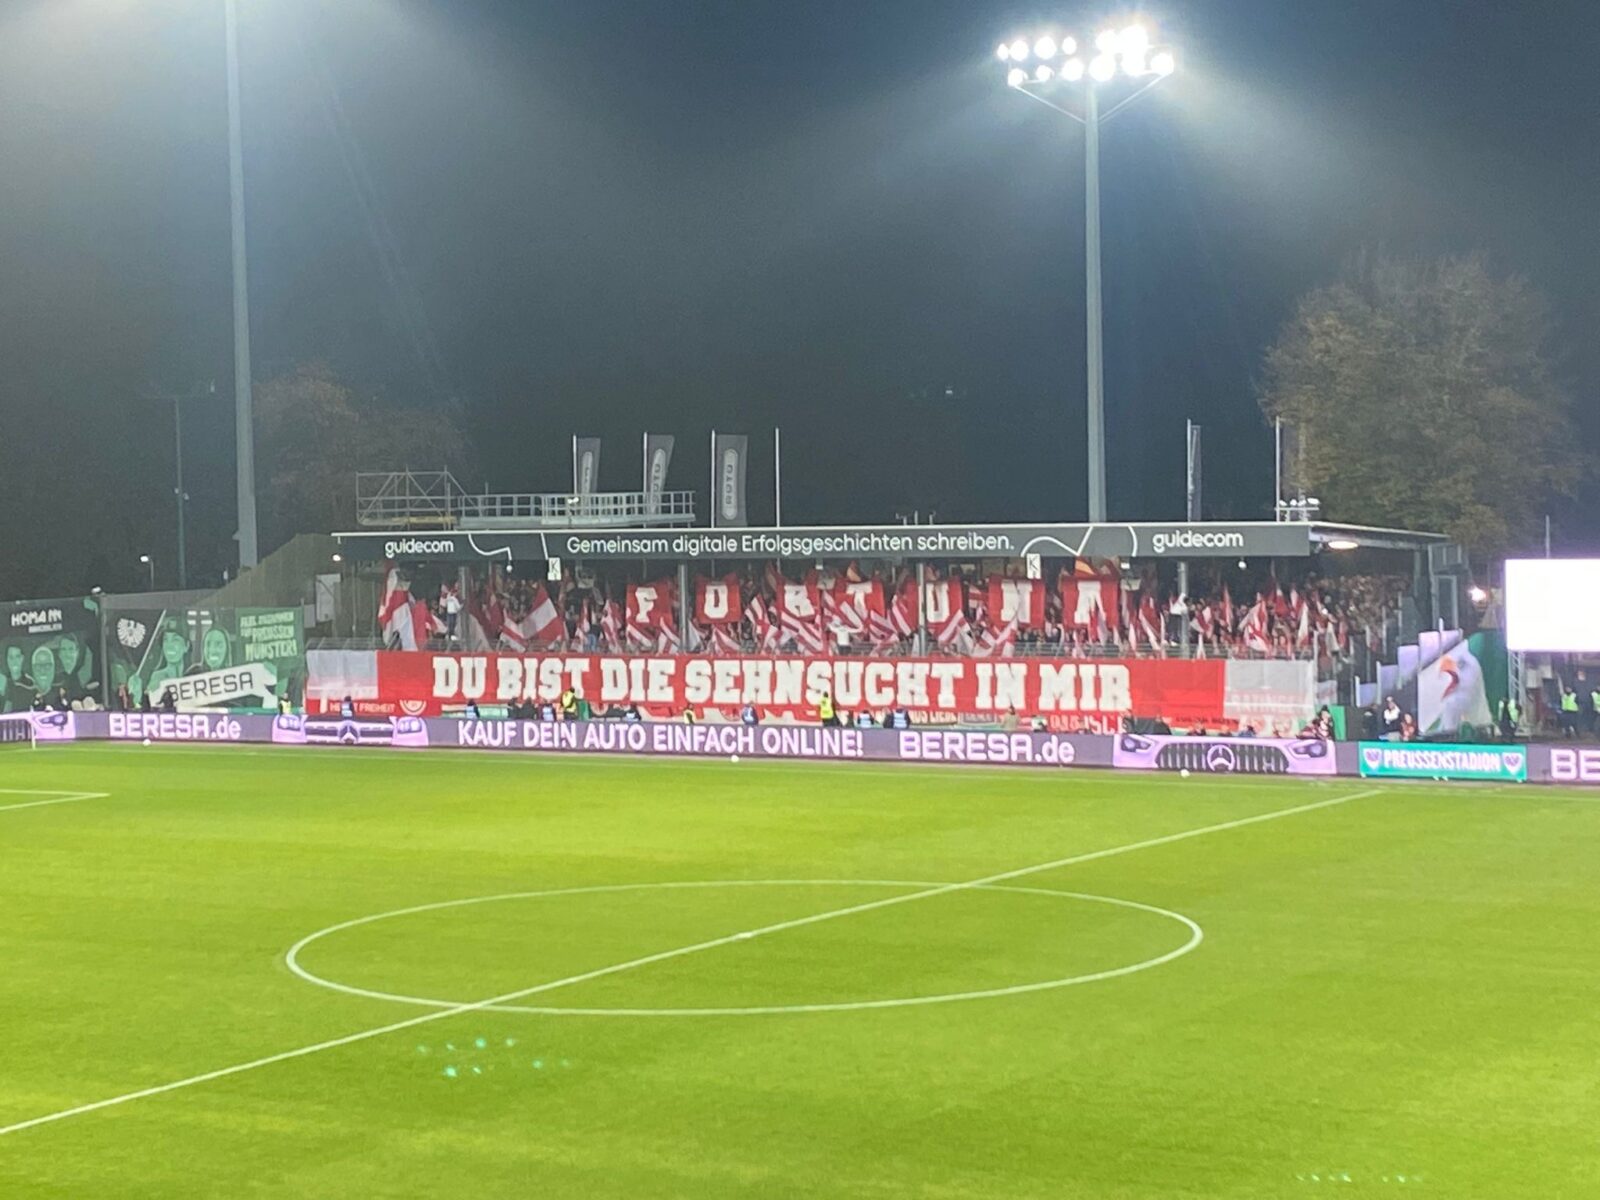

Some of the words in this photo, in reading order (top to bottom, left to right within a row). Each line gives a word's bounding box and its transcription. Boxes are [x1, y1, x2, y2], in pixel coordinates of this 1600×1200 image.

[385, 538, 454, 557] guidecom
[567, 536, 668, 554] Gemeinsam
[673, 535, 738, 555] digitale
[742, 533, 913, 556] Erfolgsgeschichten
[917, 531, 1015, 551] schreiben.
[1152, 530, 1244, 553] guidecom
[169, 672, 254, 702] BERESA
[432, 656, 488, 699] DU
[497, 657, 590, 701] BIST
[601, 658, 676, 702] DIE
[684, 659, 964, 708] SEHNSUCHT
[975, 662, 1028, 710] IN
[1038, 664, 1133, 712] MIR
[109, 713, 242, 739] BERESA.de
[458, 719, 517, 747] KAUF
[523, 721, 577, 749] DEIN
[583, 723, 647, 751] AUTO
[653, 724, 754, 753] EINFACH
[762, 728, 864, 756] ONLINE!
[900, 731, 1075, 763] BERESA.de
[1383, 749, 1501, 772] PREUSSENSTADION
